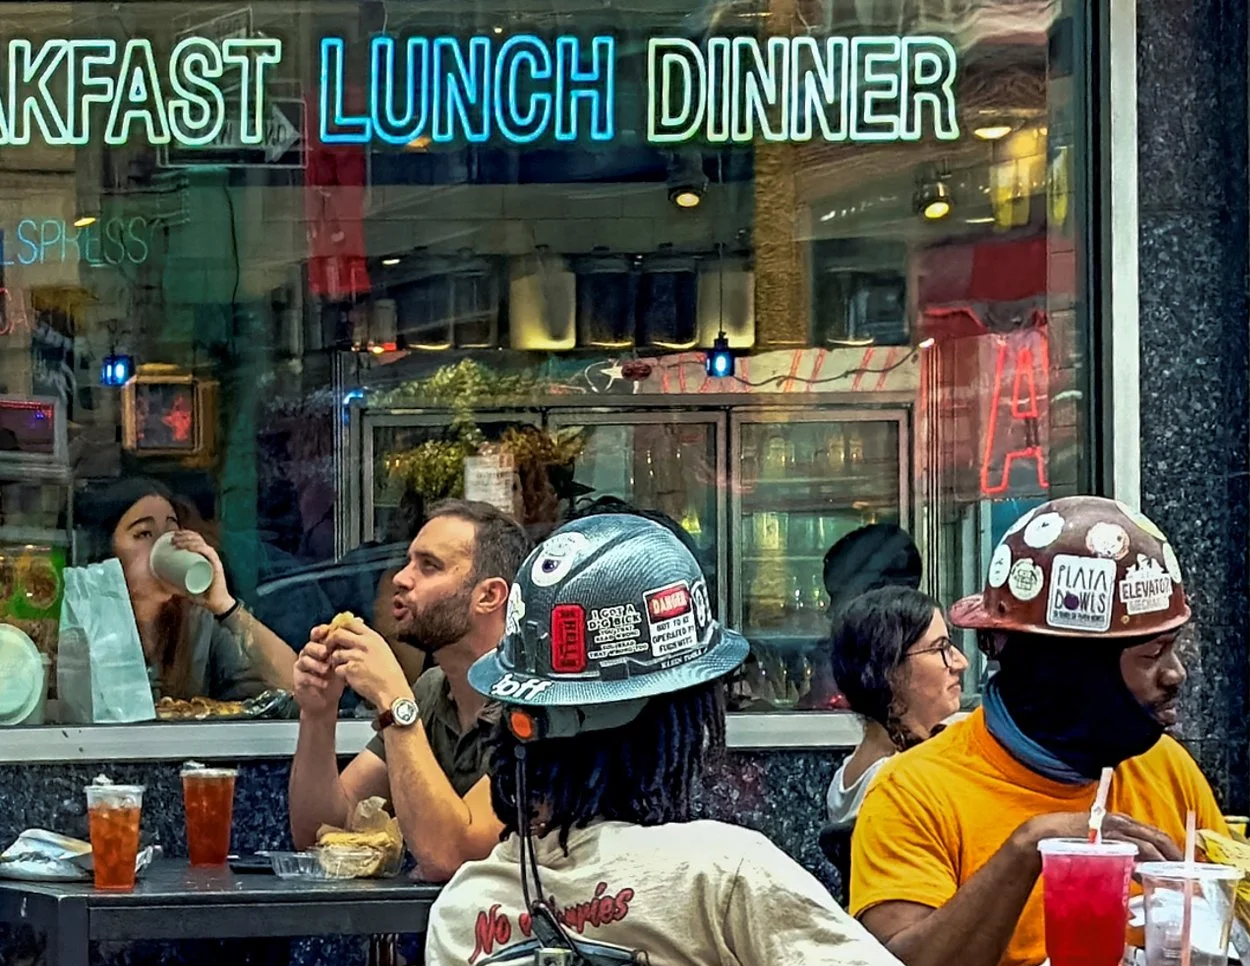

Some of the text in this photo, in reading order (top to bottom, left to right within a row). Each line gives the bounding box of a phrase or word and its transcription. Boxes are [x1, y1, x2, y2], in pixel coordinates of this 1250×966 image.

[0, 35, 960, 146] KFAST LUNCH DINNER
[467, 903, 511, 965] No
